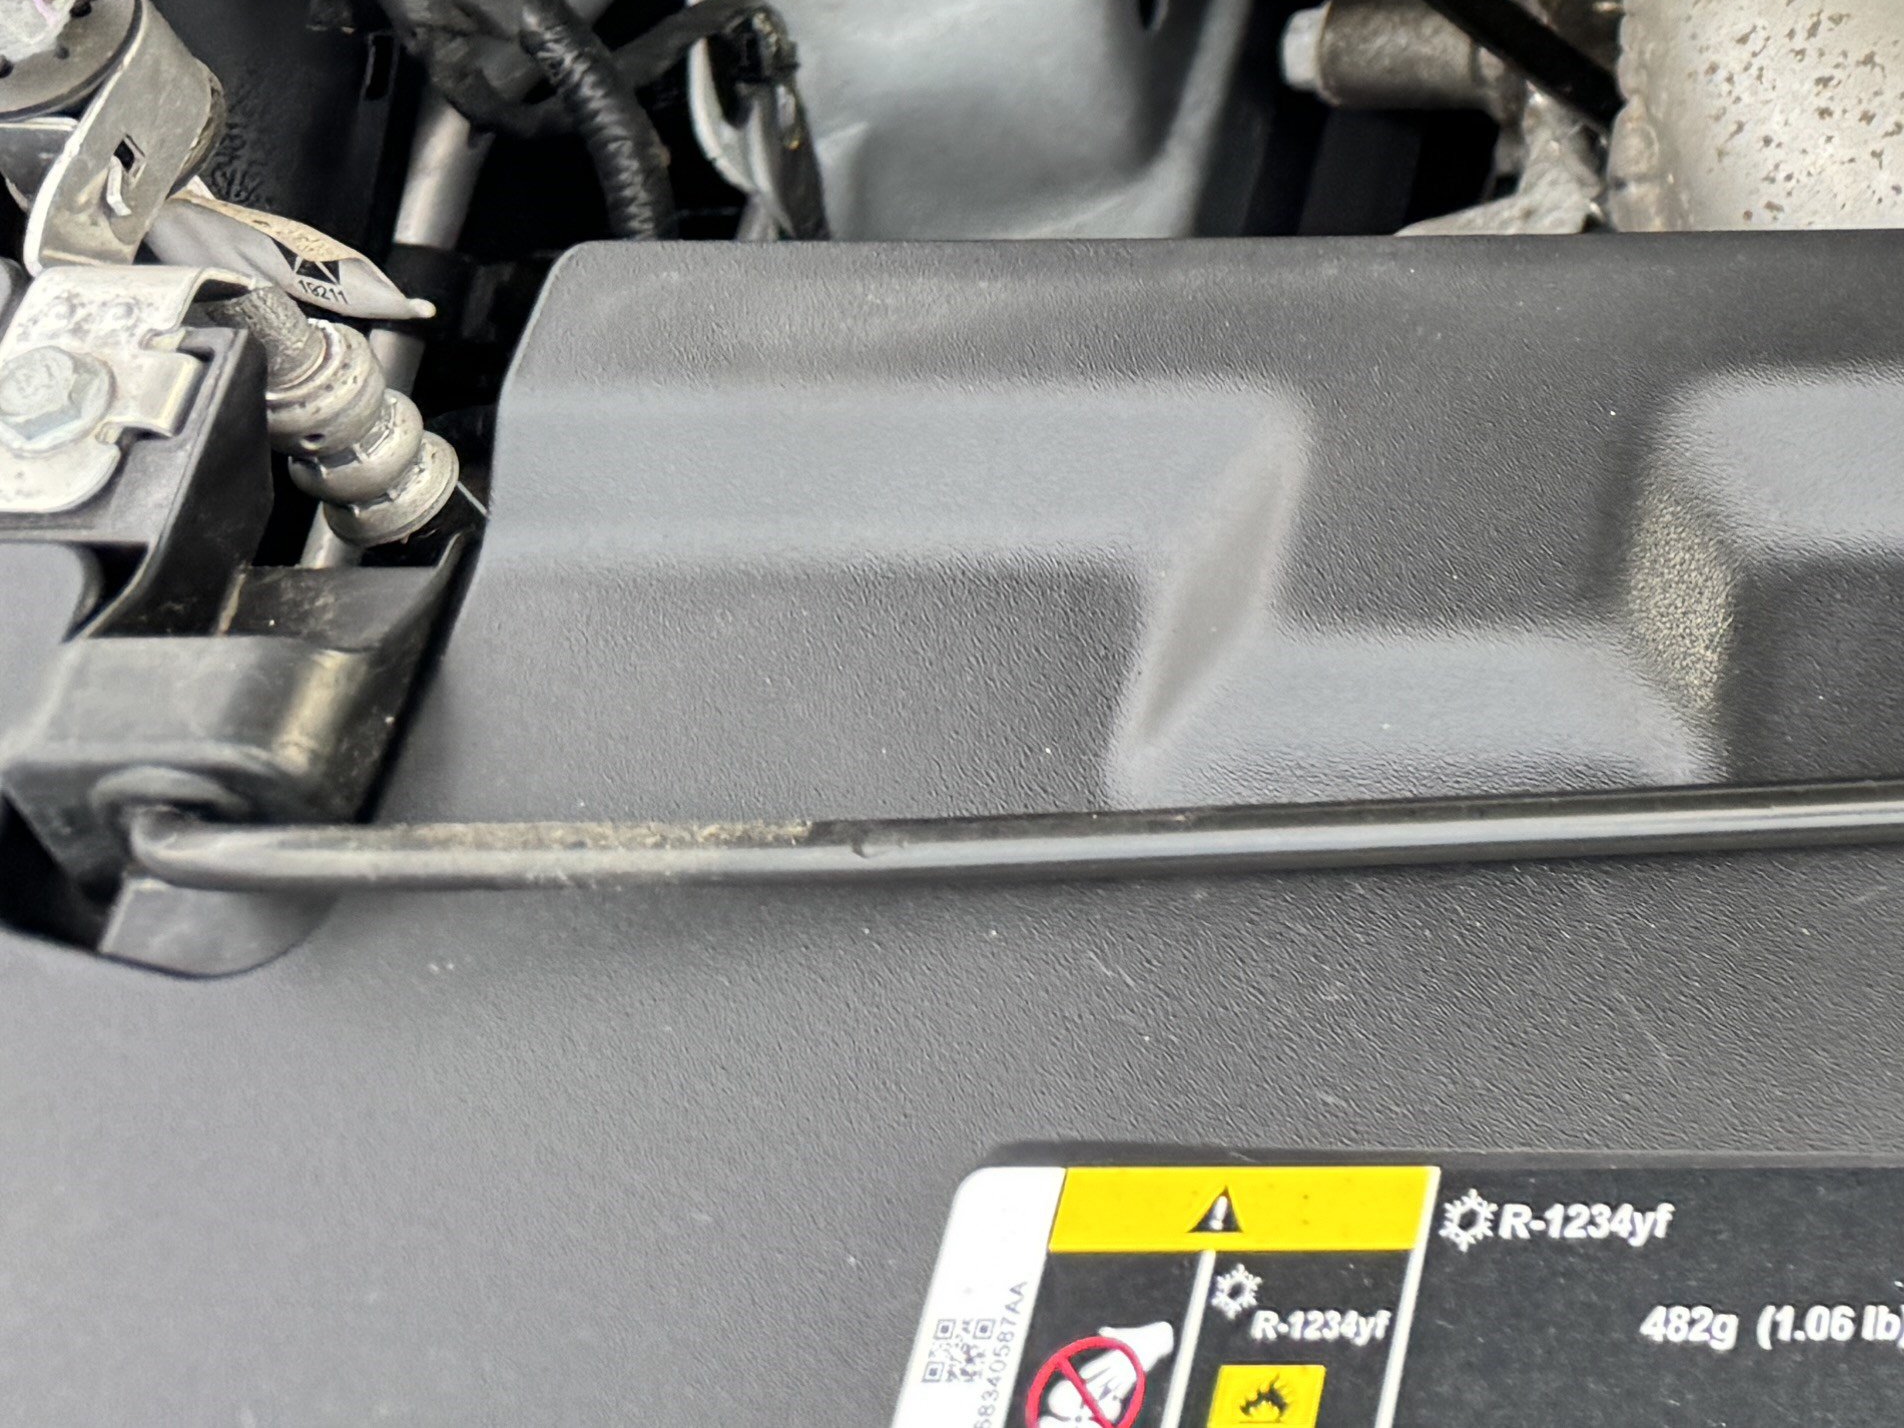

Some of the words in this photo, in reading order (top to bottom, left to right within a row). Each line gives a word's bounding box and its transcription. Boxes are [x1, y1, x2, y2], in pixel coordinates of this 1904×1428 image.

[1496, 1203, 1673, 1246] R-1234yf
[1250, 1309, 1392, 1346] R-1234yf
[1640, 1306, 1738, 1352] 482g
[1756, 1304, 1856, 1348] (1.06
